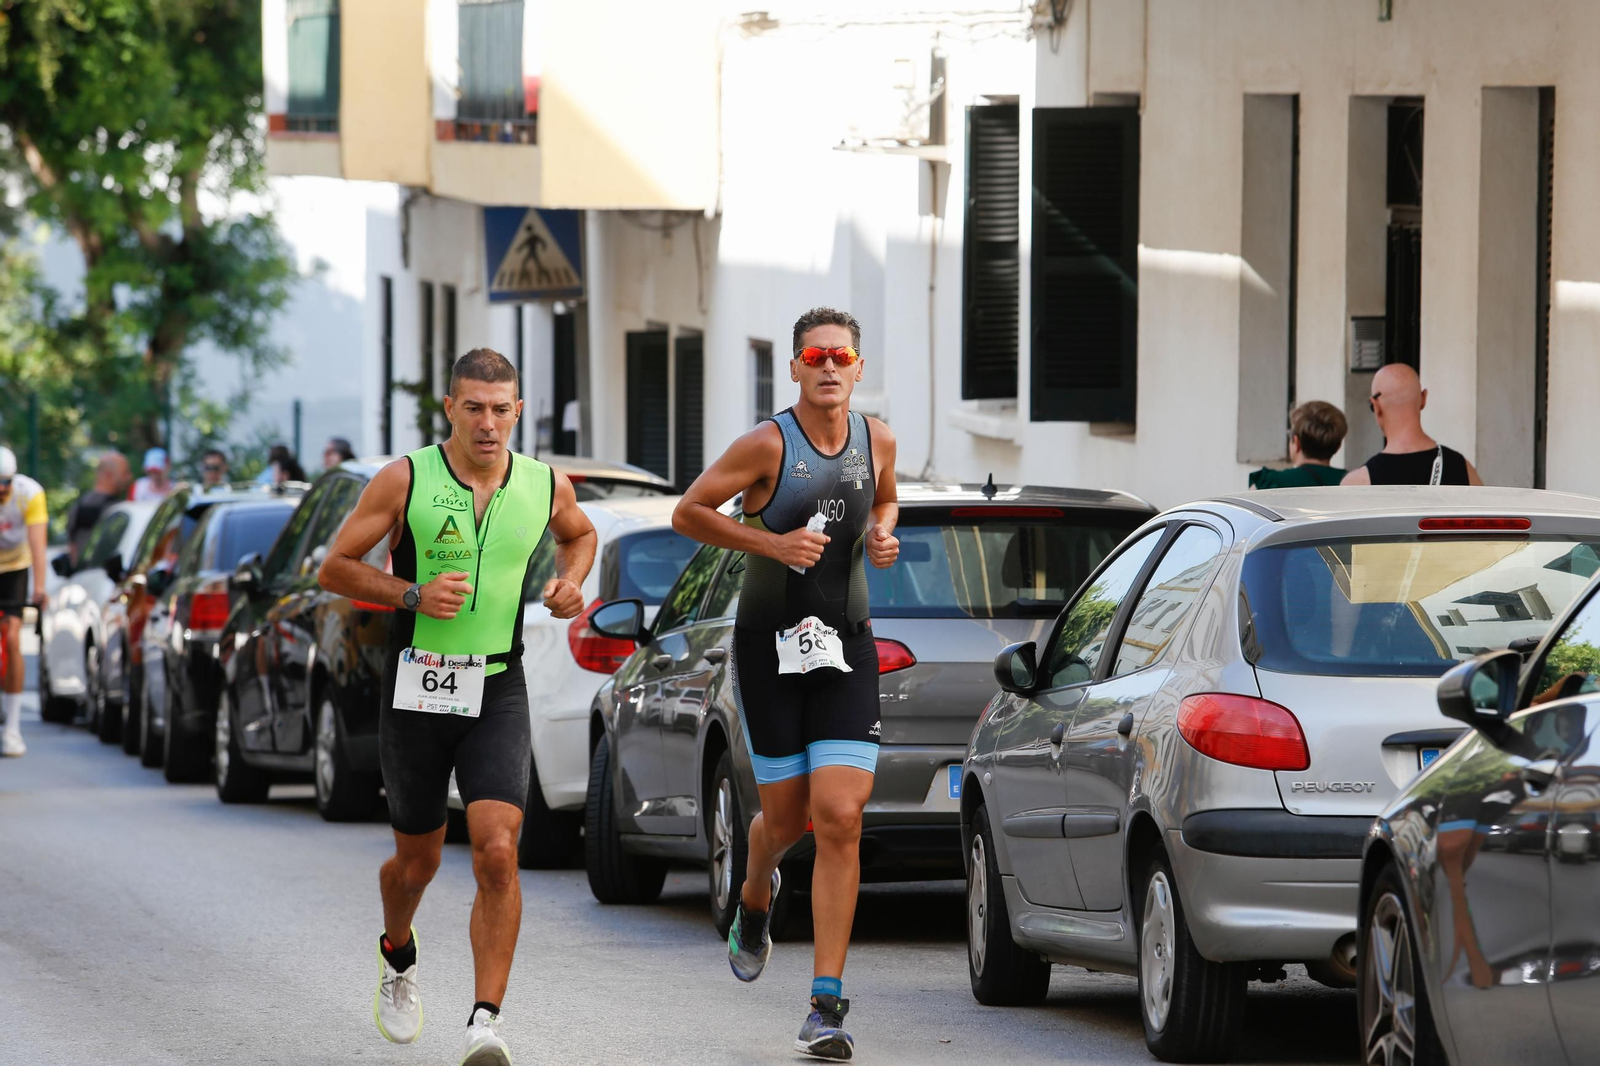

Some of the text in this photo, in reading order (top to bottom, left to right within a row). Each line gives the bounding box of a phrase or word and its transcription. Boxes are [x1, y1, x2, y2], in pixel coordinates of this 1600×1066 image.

[433, 494, 468, 507] Casares
[817, 499, 846, 522] VIGO
[437, 550, 472, 559] GAVA
[422, 670, 458, 695] 64
[879, 693, 908, 703] OLF
[953, 785, 959, 793] E
[1291, 781, 1376, 793] PEUGEOT
